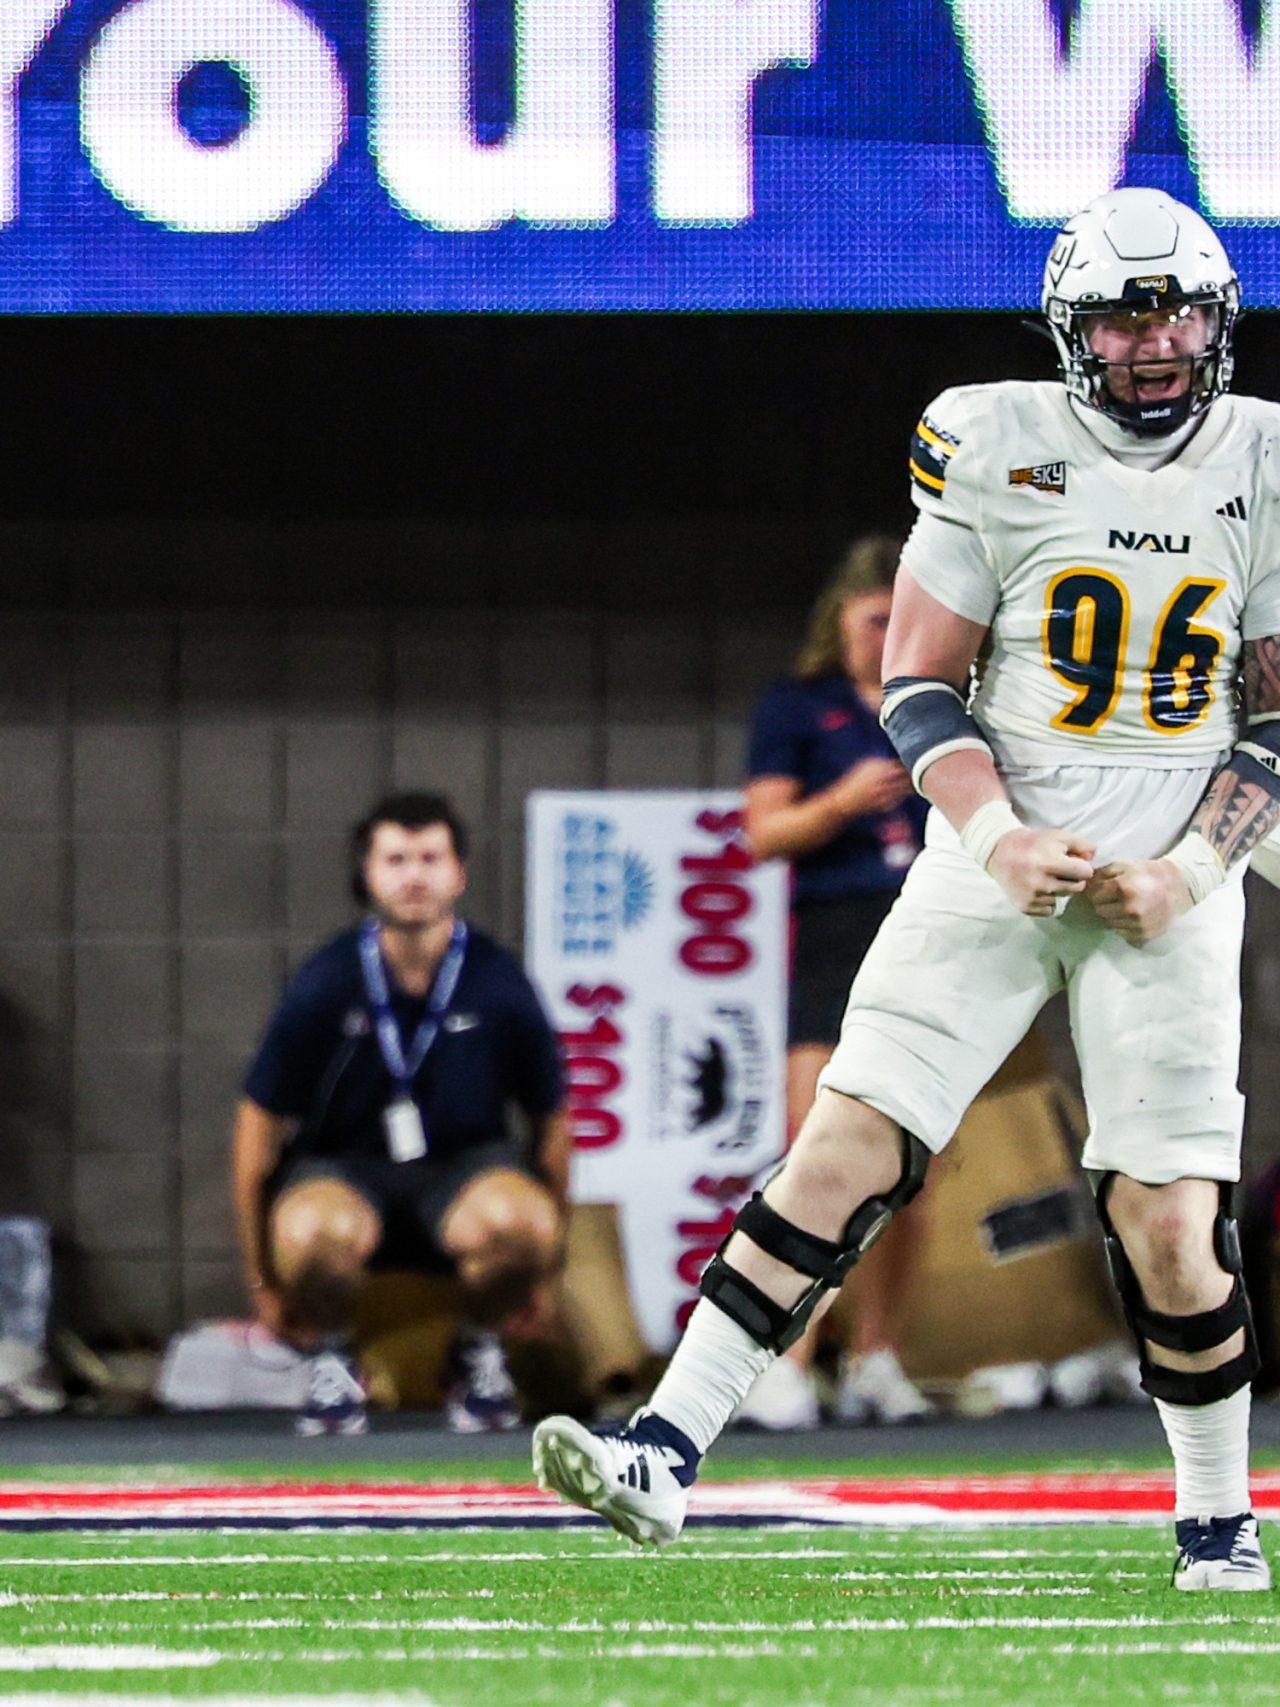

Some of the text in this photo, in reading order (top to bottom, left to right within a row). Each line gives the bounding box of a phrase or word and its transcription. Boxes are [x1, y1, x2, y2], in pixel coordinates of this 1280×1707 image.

[0, 0, 815, 232] our
[1032, 463, 1064, 485] SKY
[1108, 529, 1191, 554] NAU
[1041, 566, 1227, 735] 96
[679, 809, 755, 977] $100
